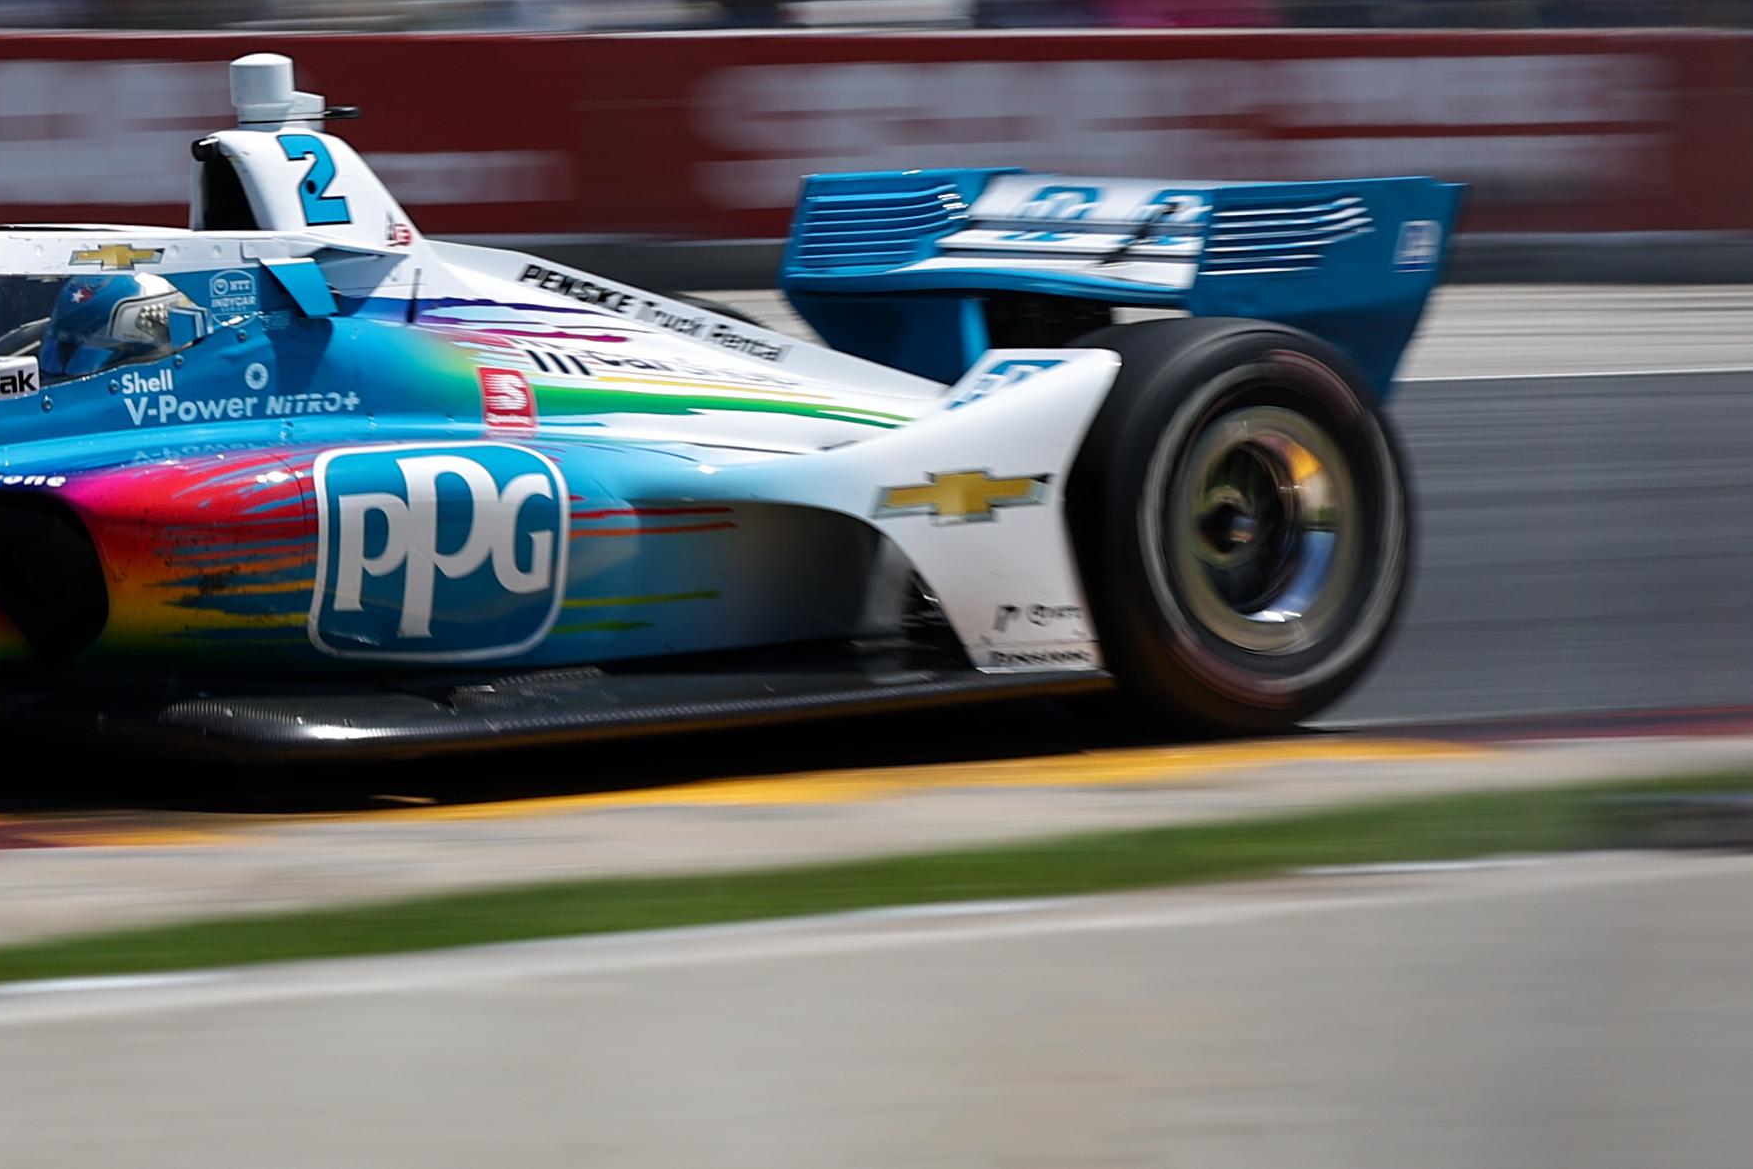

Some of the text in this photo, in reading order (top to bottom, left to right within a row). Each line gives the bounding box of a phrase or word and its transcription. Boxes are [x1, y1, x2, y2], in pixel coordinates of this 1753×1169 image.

[275, 133, 352, 227] 2
[519, 263, 633, 313] PENSKE
[121, 369, 174, 395] Shell
[124, 395, 259, 426] V-Power
